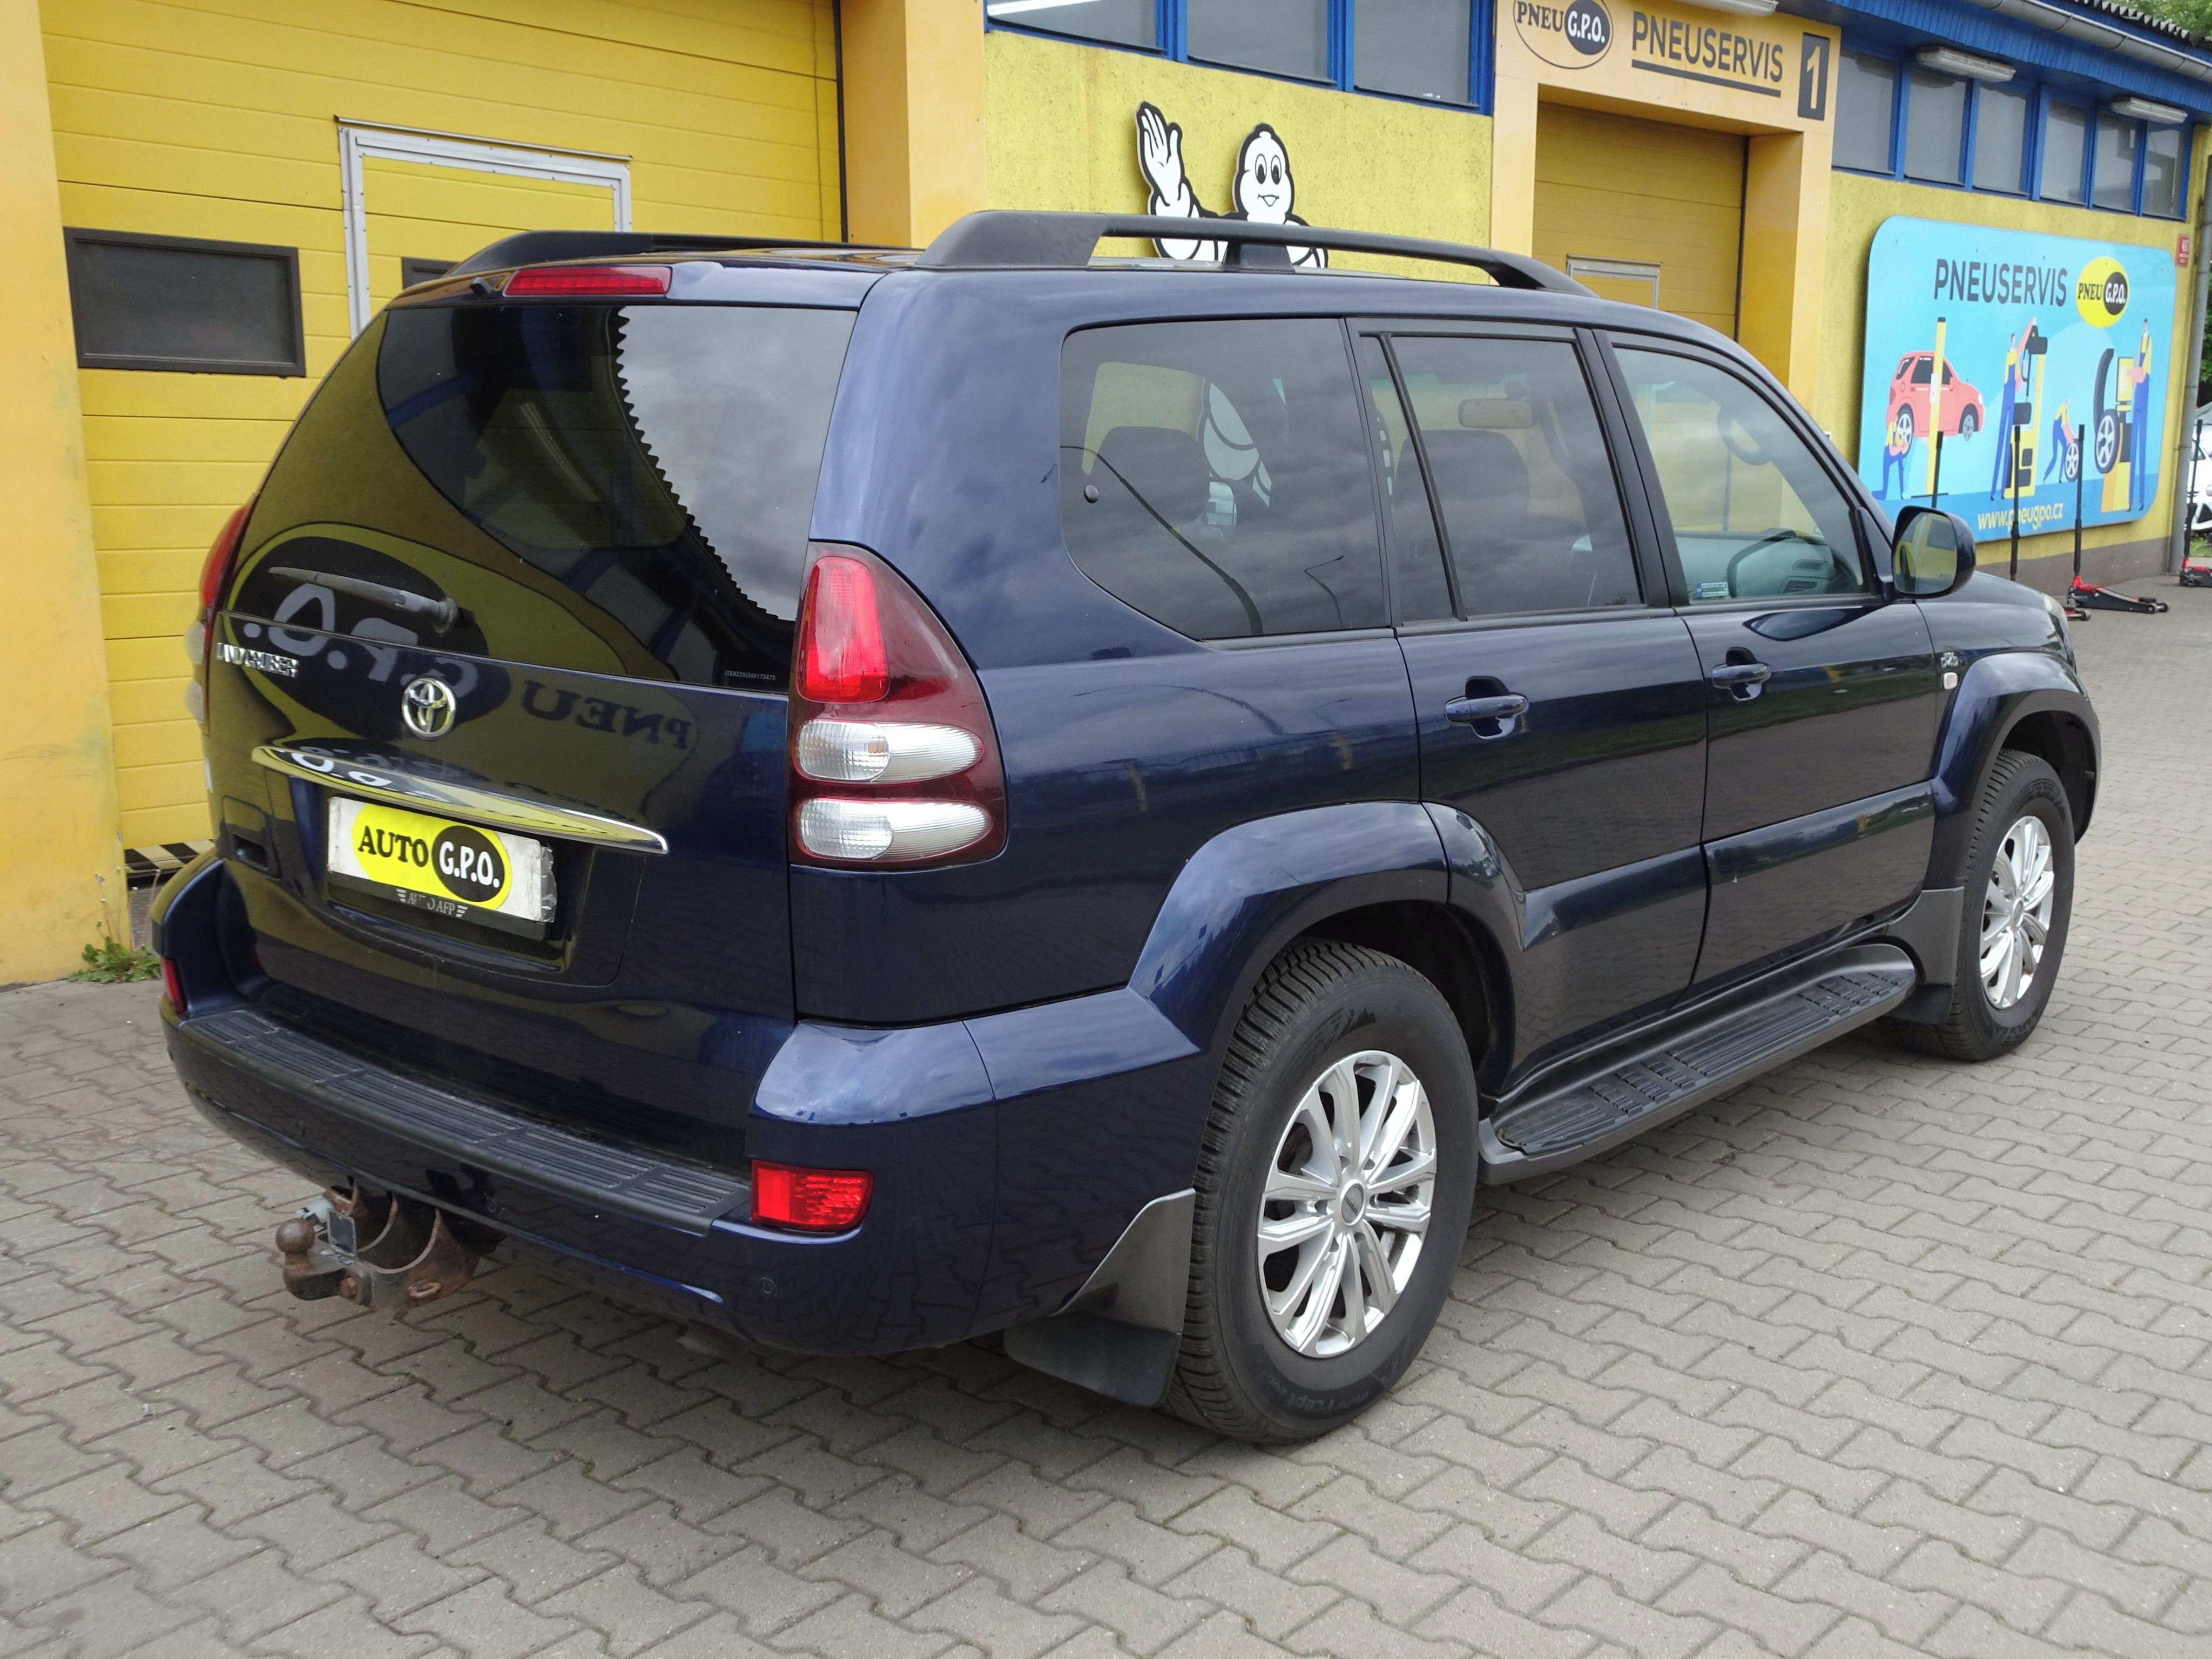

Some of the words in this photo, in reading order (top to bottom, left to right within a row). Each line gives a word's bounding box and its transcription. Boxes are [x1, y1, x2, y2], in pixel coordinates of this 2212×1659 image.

[1517, 1, 1564, 32] PNEU
[1567, 10, 1606, 43] G.P.O.
[1632, 11, 1783, 82] PNEUSERVIS
[1806, 45, 1821, 110] 1
[1934, 259, 2068, 307] PNEUSERVIS
[2078, 283, 2103, 300] PNEU
[2105, 282, 2126, 304] G.P.O.
[358, 825, 429, 867] AUTO
[439, 841, 500, 888] G.P.O.
[436, 900, 455, 915] AFP
